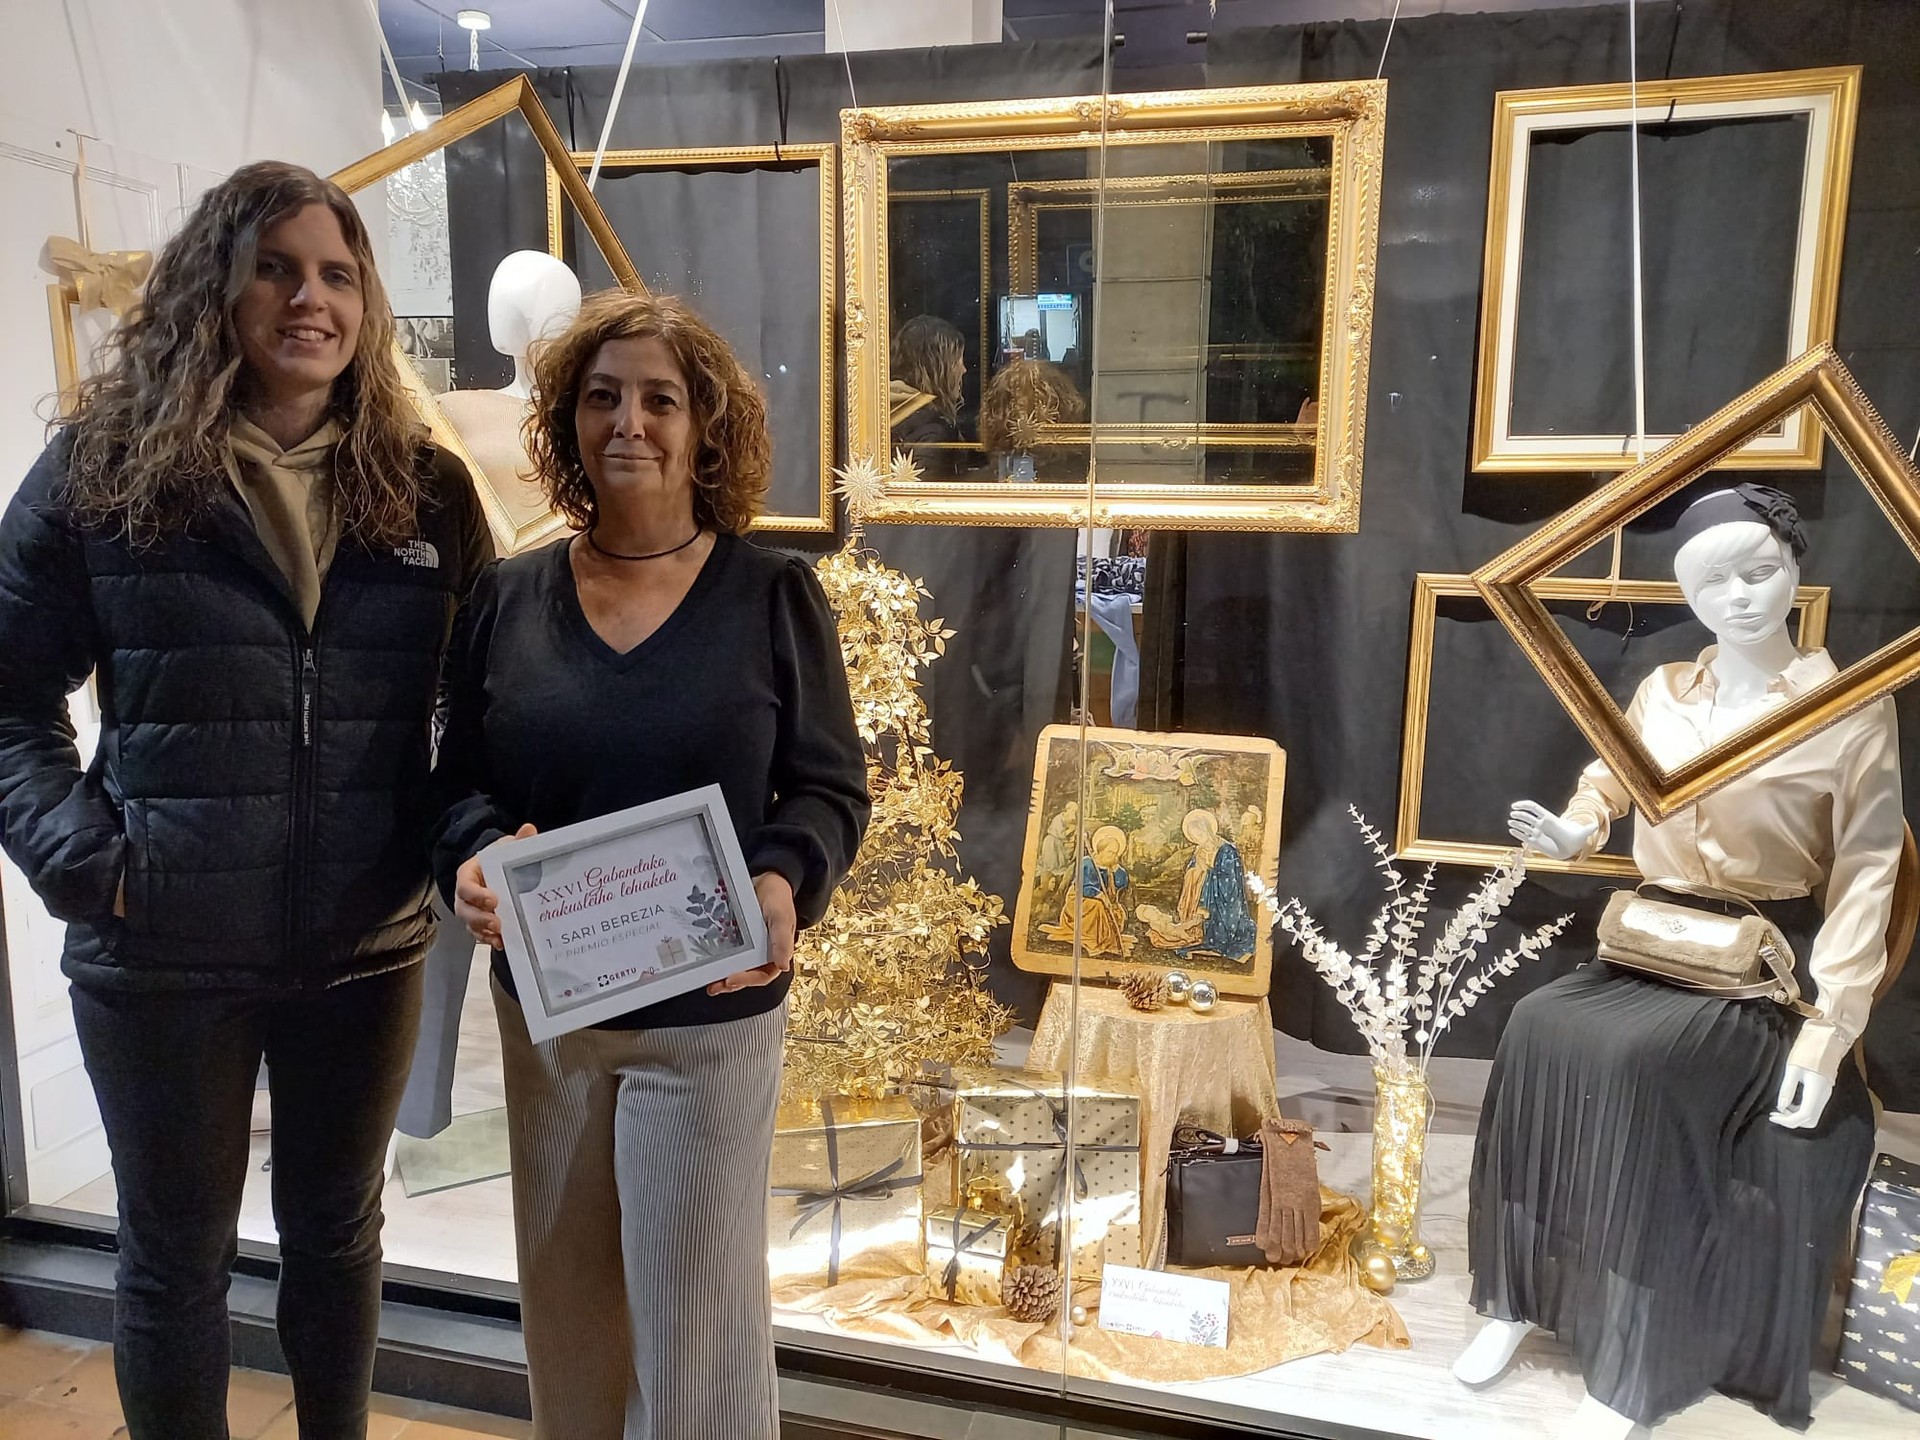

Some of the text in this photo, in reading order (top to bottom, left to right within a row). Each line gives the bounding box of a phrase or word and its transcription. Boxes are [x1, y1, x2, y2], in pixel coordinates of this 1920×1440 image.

[408, 540, 426, 550] THE
[394, 548, 426, 559] NORTH
[402, 556, 426, 567] FACE
[537, 881, 583, 905] XXVI
[561, 925, 597, 945] SARI
[601, 904, 665, 932] BEREZIA
[565, 937, 610, 959] PREMIO
[611, 921, 662, 945] ESPECIAL
[609, 967, 638, 982] GERTU
